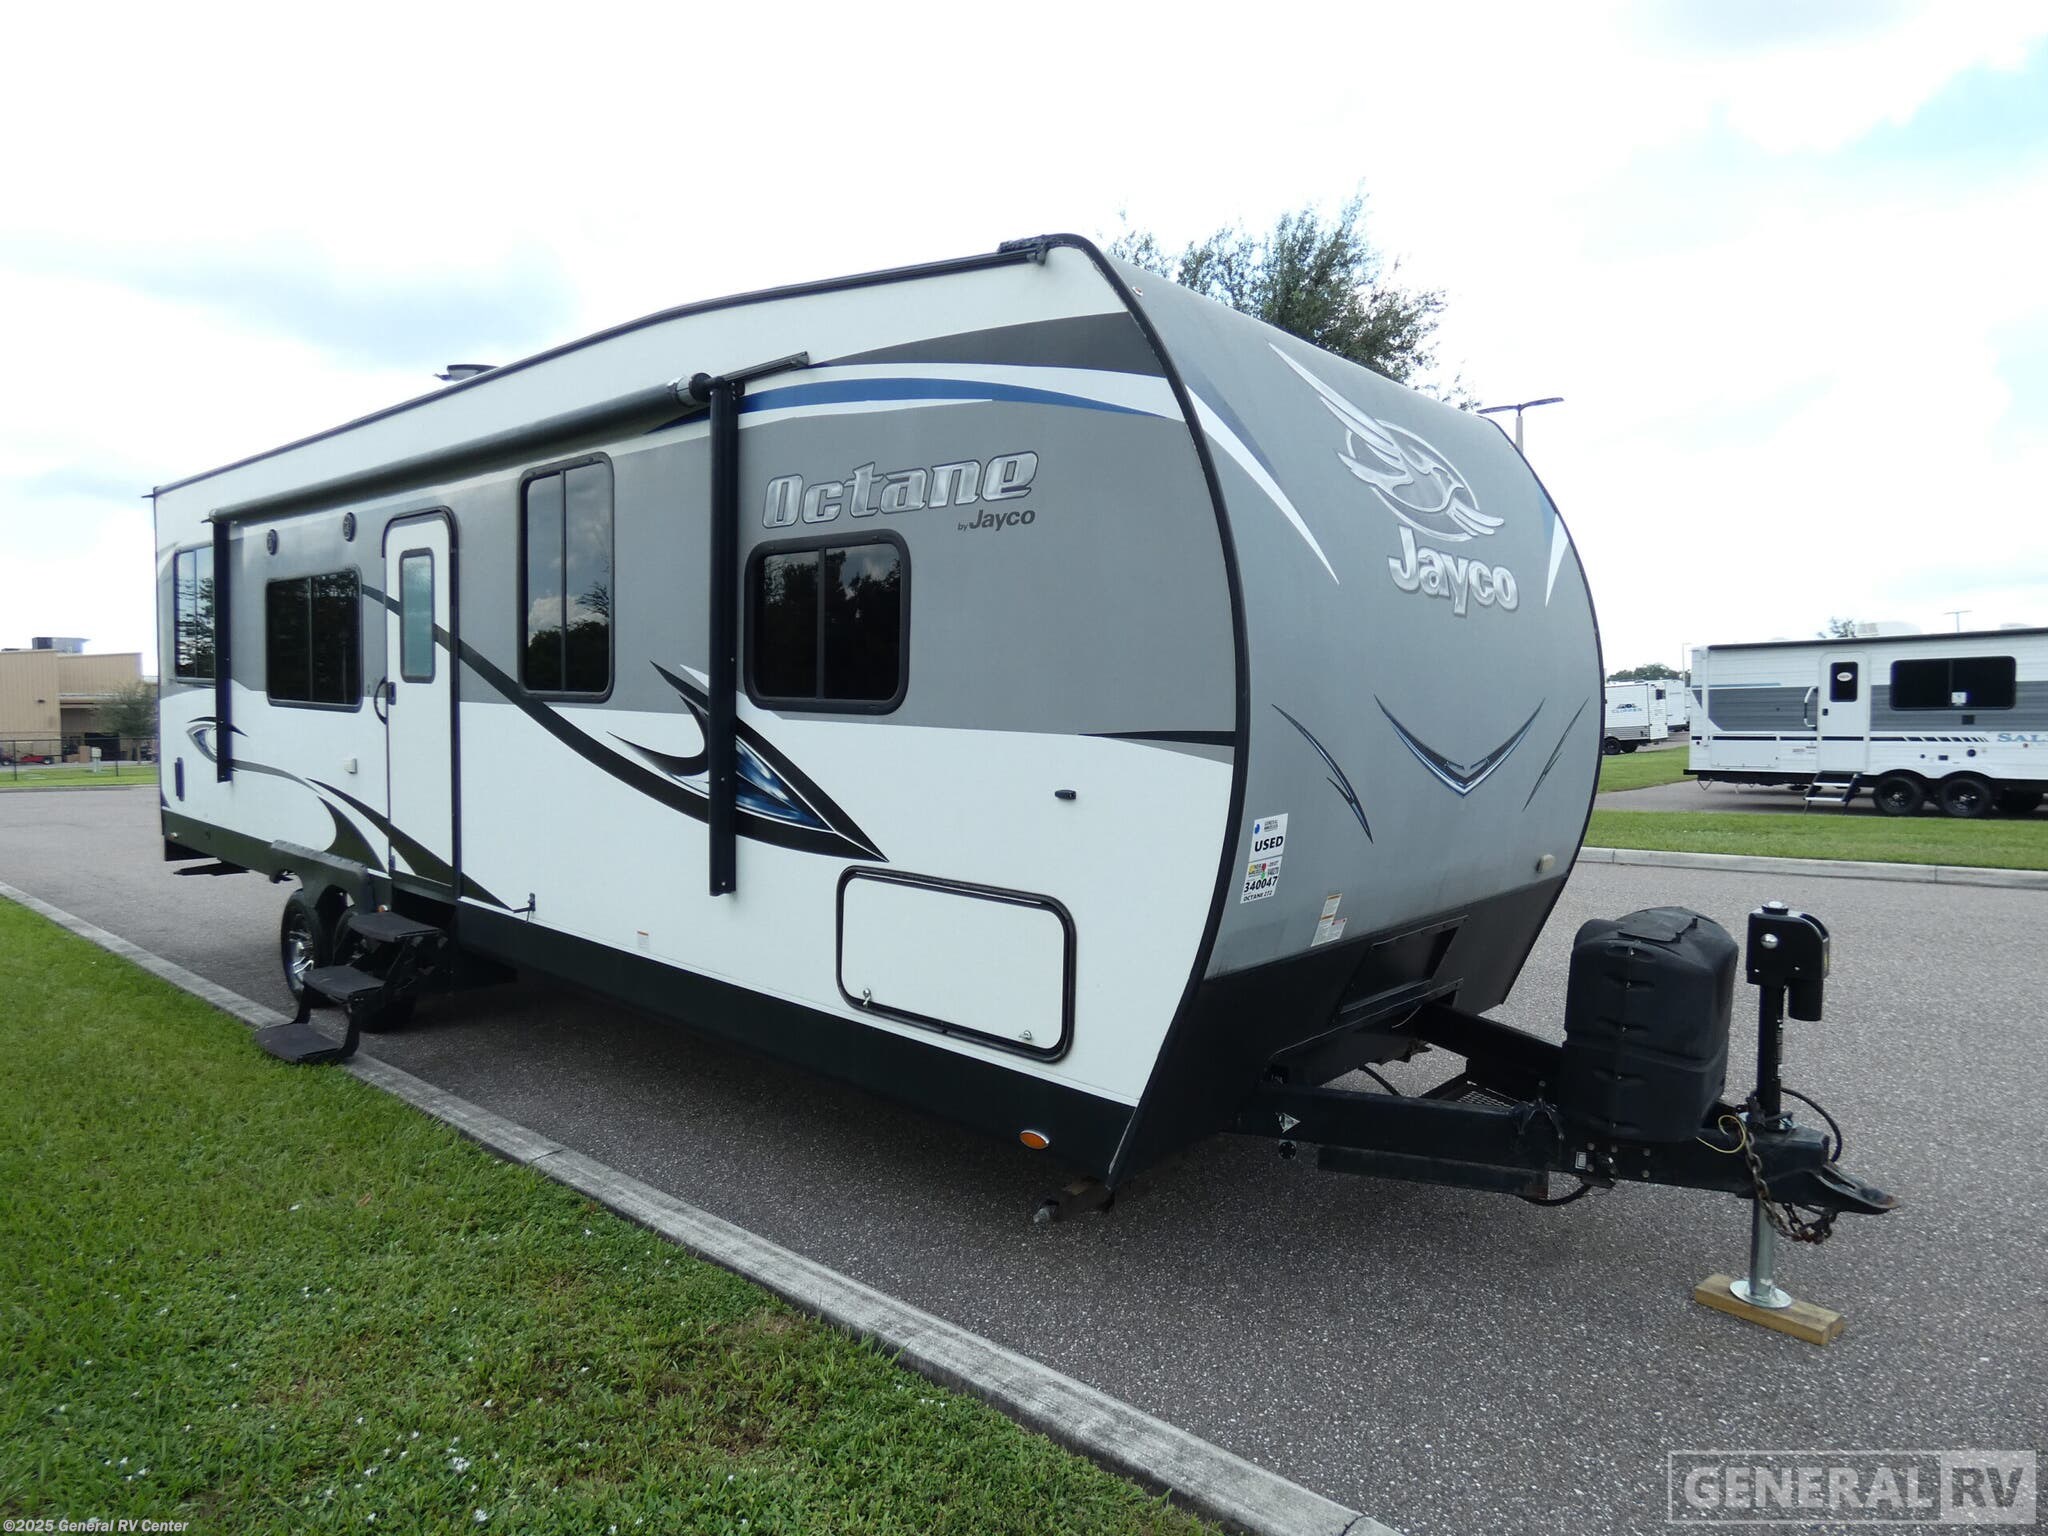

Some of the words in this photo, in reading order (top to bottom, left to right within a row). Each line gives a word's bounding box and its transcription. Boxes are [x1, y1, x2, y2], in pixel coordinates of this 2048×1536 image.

[762, 451, 1039, 529] Octane
[957, 522, 968, 531] by
[969, 509, 1036, 531] Jayco
[1387, 524, 1519, 617] Jayco
[1997, 732, 2048, 742] SAL
[1254, 835, 1284, 852] USED
[1243, 876, 1278, 893] 340047
